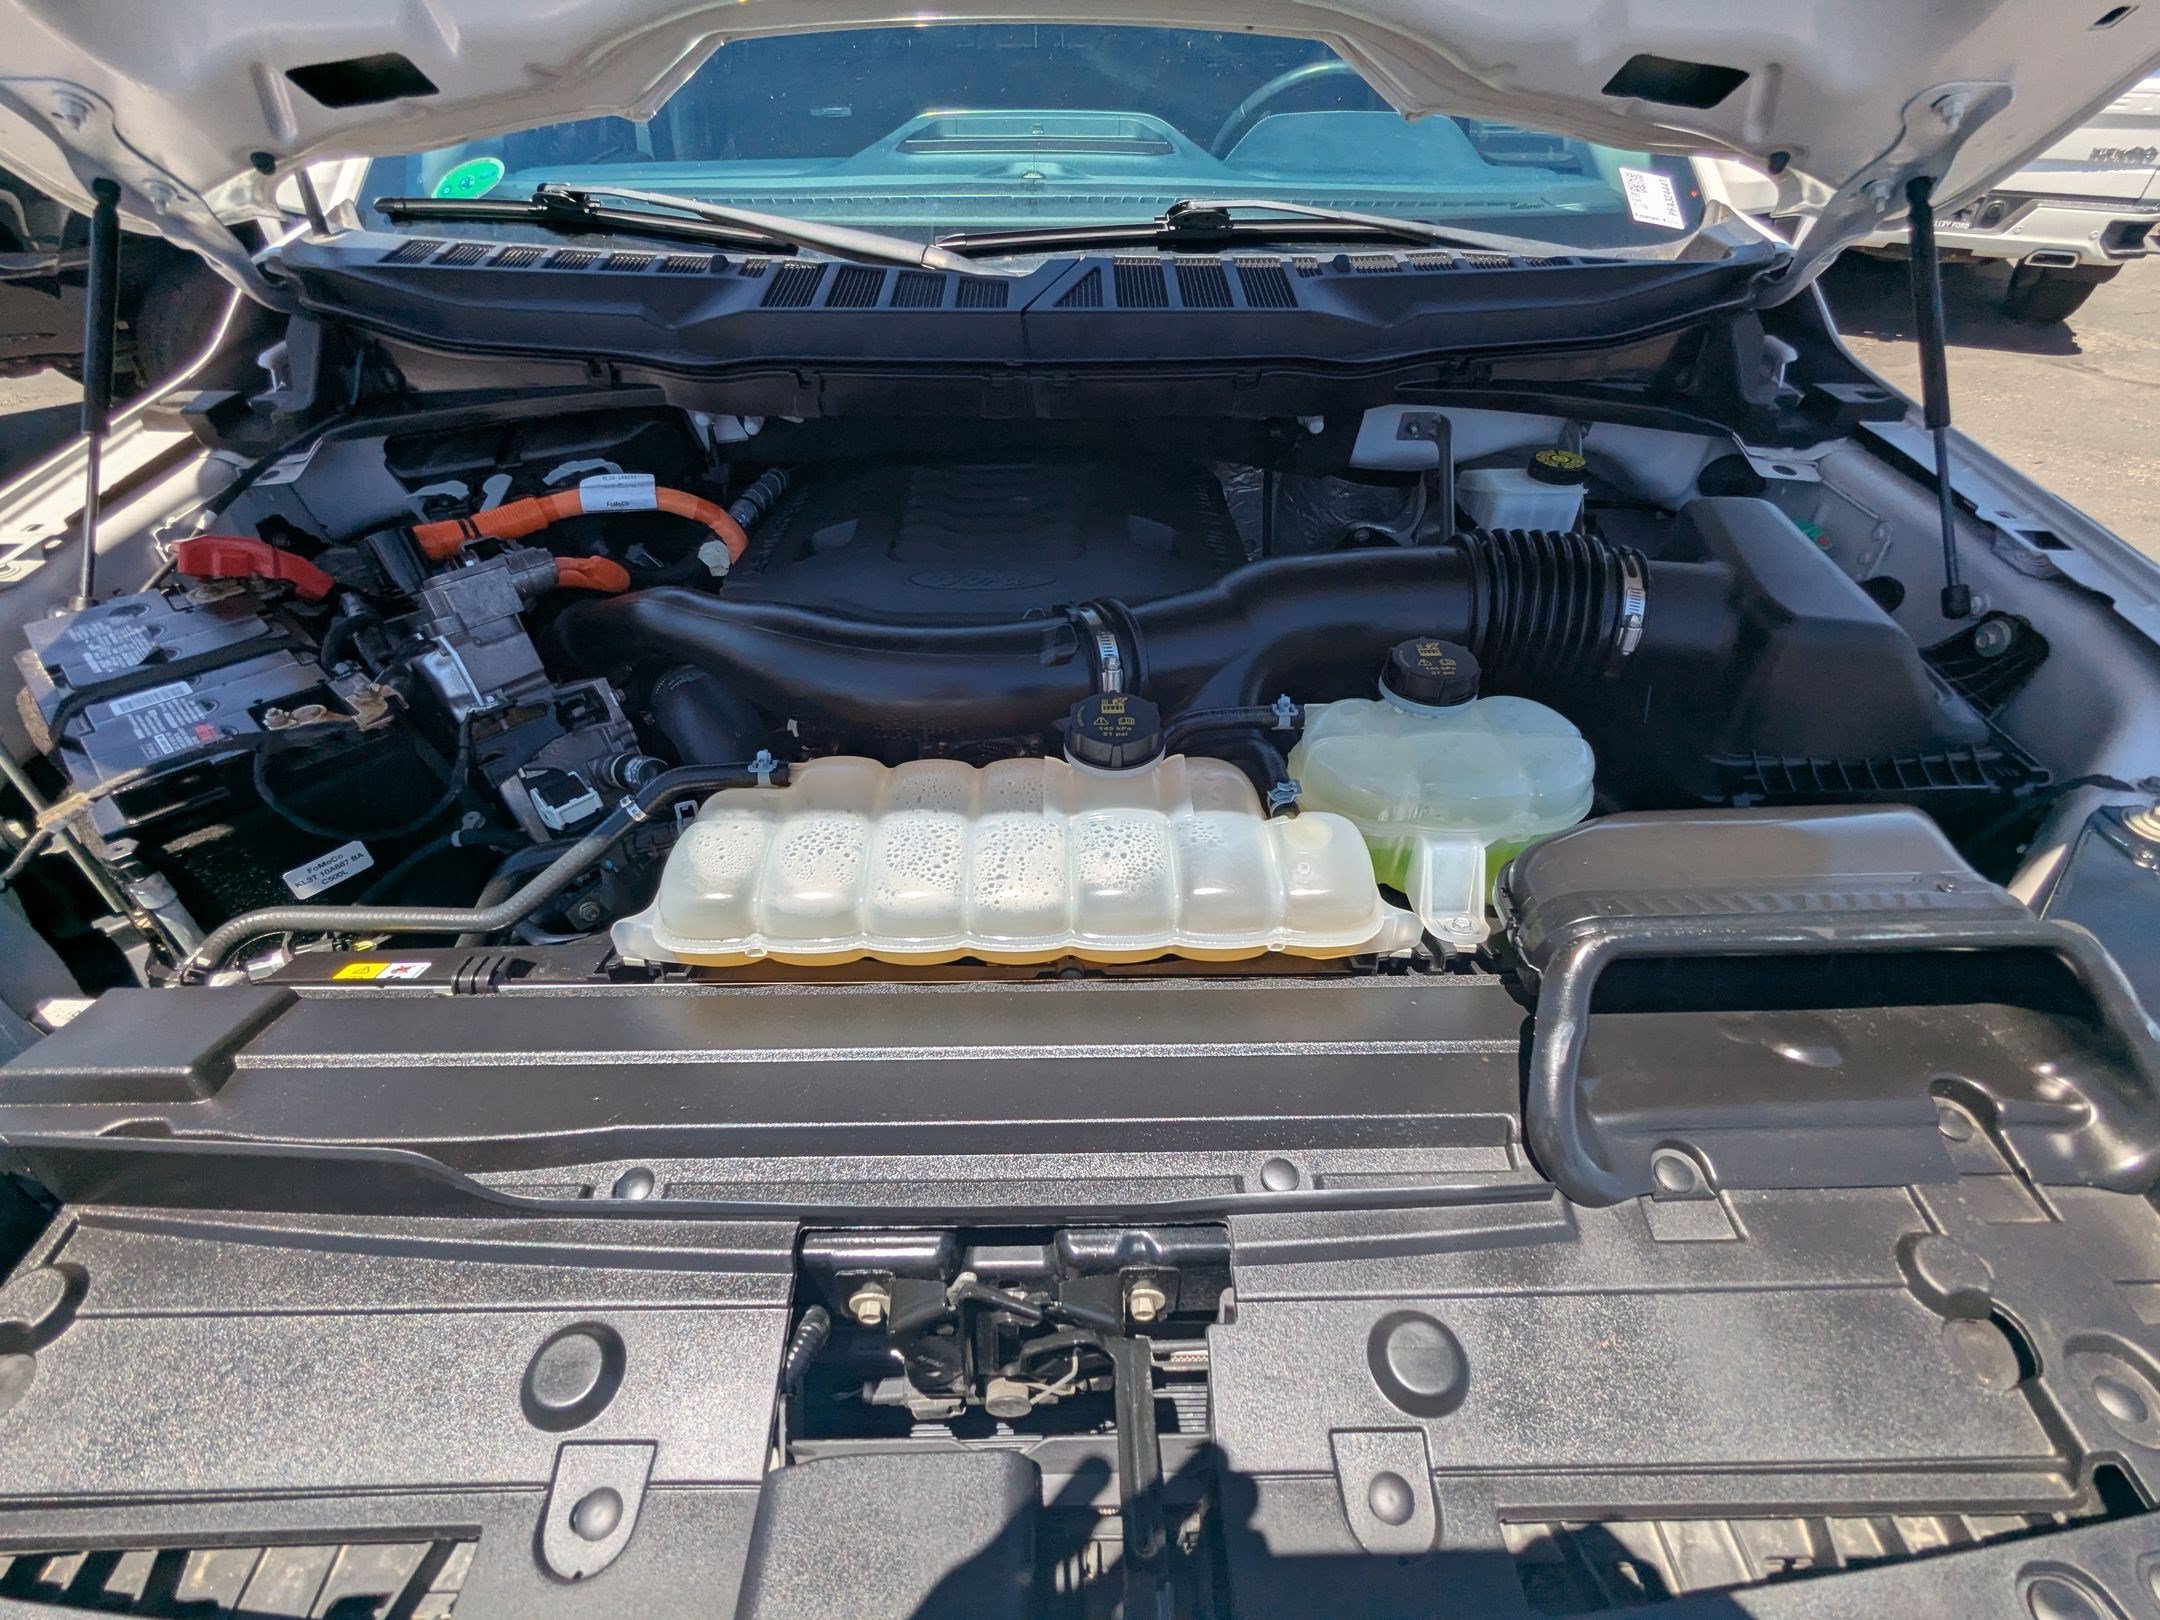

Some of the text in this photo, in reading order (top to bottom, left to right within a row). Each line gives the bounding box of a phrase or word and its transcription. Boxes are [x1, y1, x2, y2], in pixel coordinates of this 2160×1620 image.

[294, 874, 317, 888] KL3T
[350, 852, 364, 862] BA
[306, 854, 343, 874] FoMoCo
[321, 870, 348, 885] C500L
